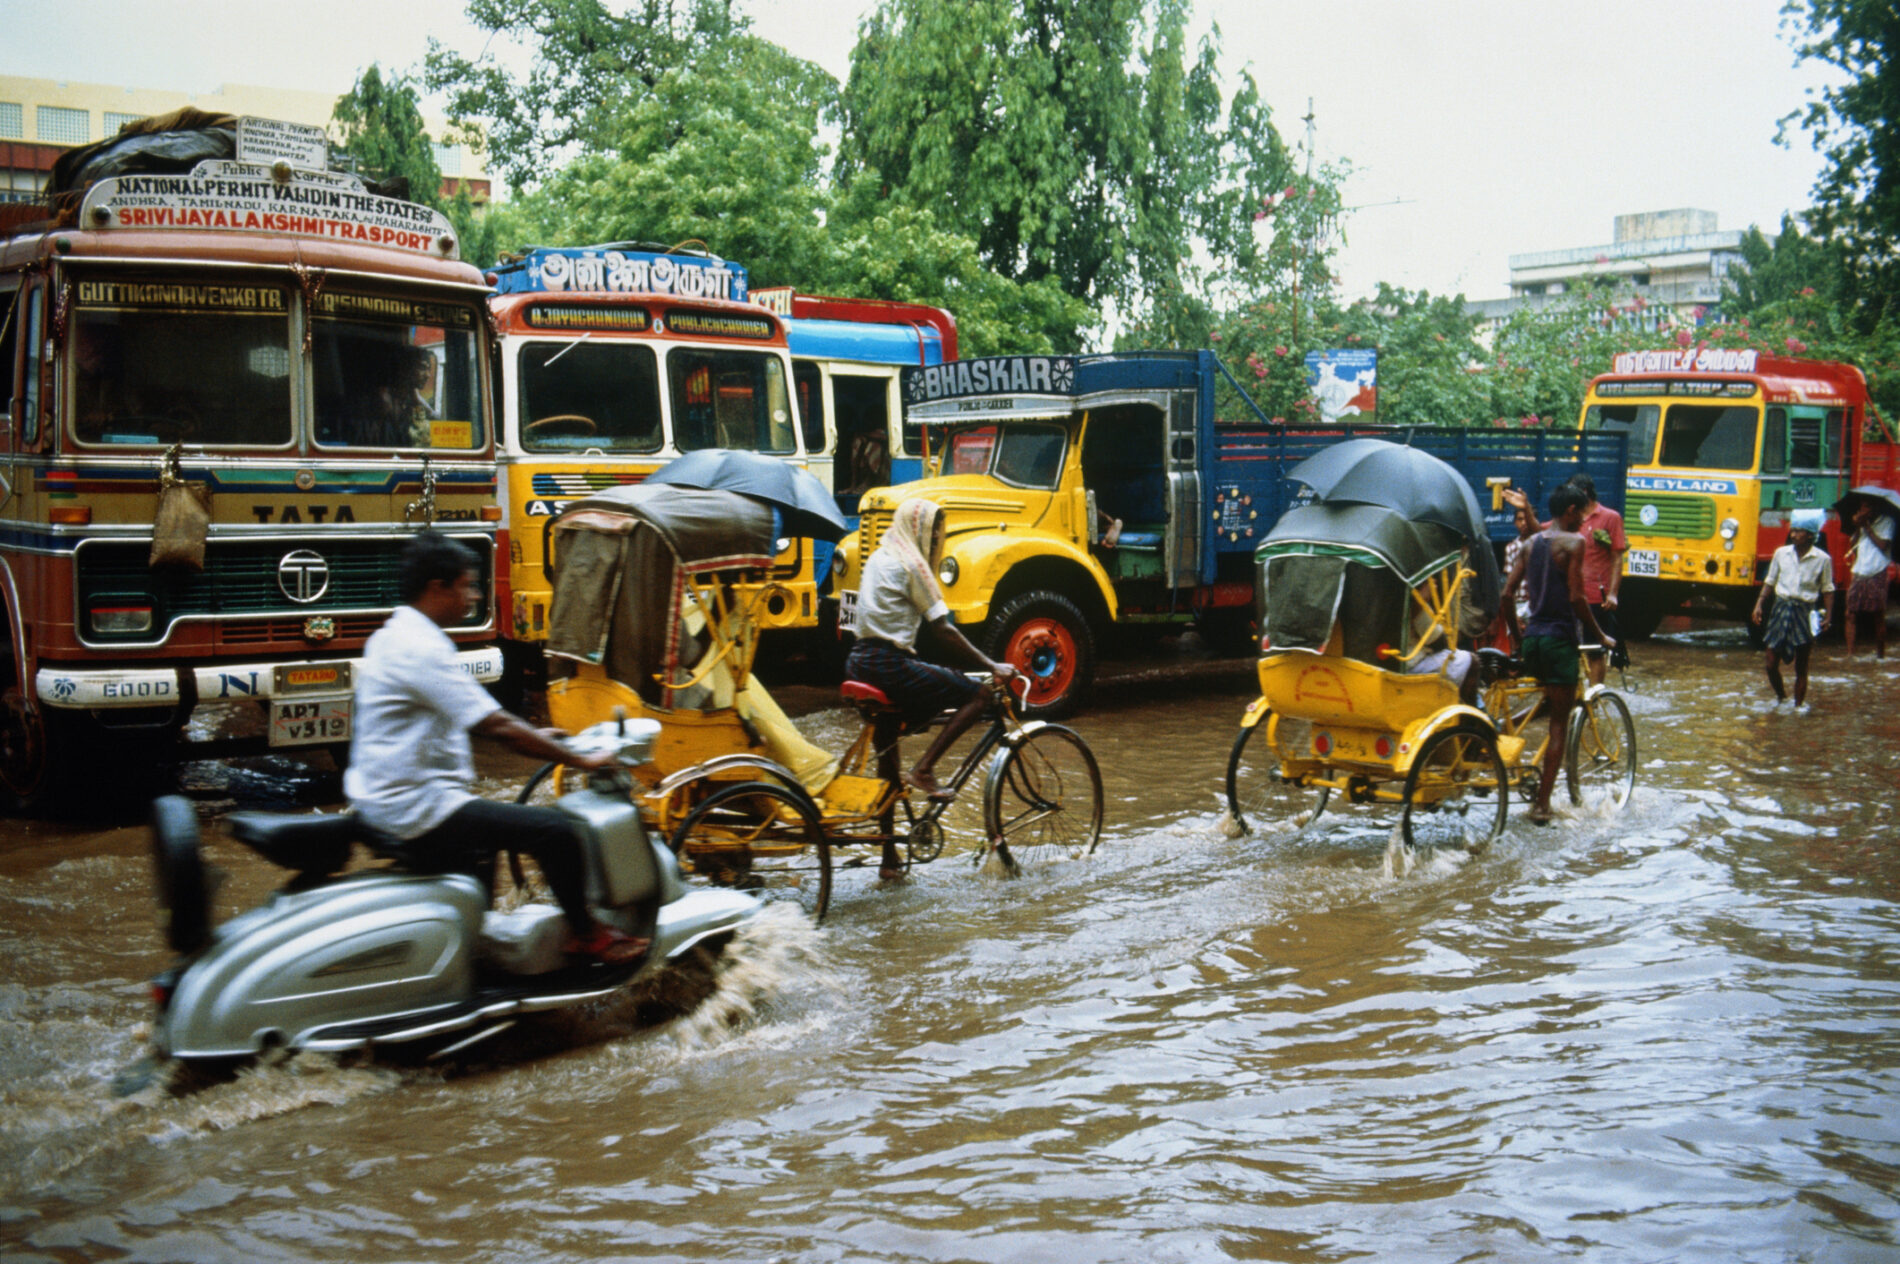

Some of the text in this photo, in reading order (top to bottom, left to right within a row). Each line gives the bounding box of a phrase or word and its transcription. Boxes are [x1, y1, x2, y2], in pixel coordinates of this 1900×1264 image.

[245, 119, 318, 137] NATIONAL PERMIT
[222, 162, 343, 185] Public Carrier
[117, 178, 204, 195] NATIONAL
[205, 180, 270, 199] PERMIT
[272, 183, 321, 206] VALID
[322, 190, 341, 208] IN
[342, 193, 374, 212] THE
[925, 357, 1053, 400] BHASKAR
[252, 505, 356, 523] TATA
[1630, 551, 1658, 562] TNJ
[1630, 562, 1658, 574] 1635
[103, 681, 180, 698] GOOD
